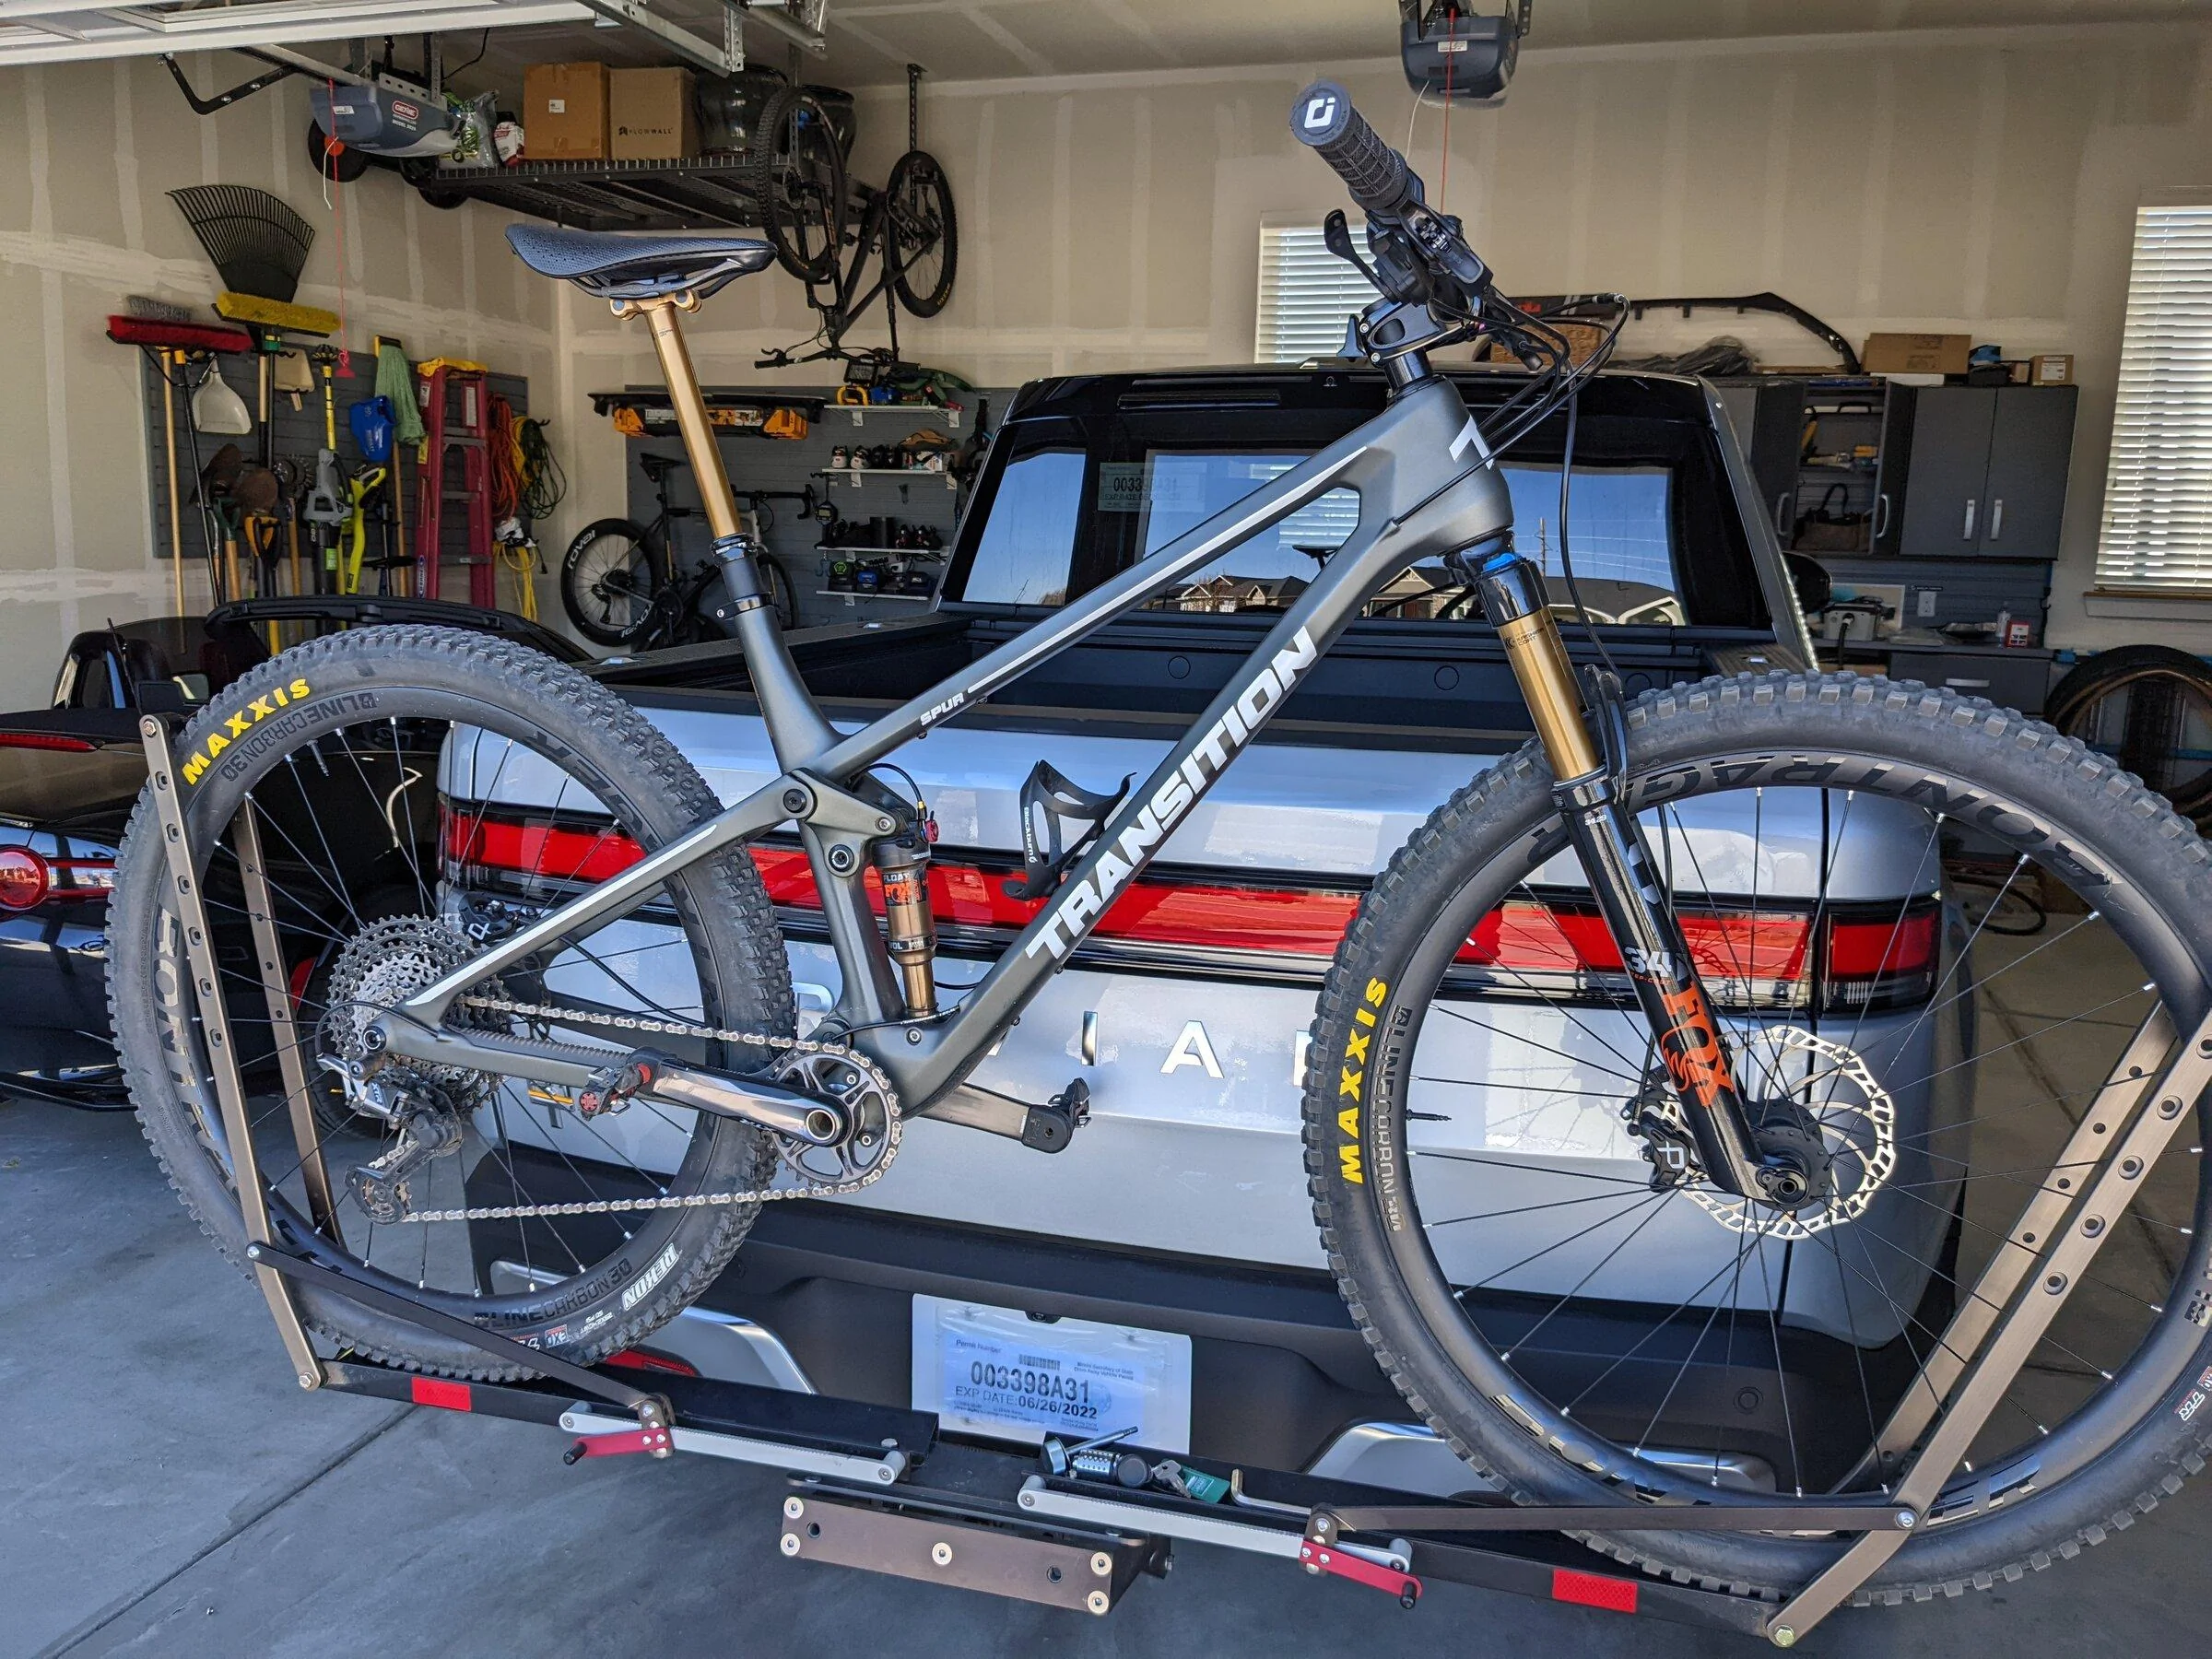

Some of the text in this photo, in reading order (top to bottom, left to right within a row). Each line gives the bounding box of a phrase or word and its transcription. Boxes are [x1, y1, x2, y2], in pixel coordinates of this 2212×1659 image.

[567, 529, 596, 570] roval
[182, 678, 311, 786] MAXXIS
[920, 692, 965, 726] SPUR
[1025, 625, 1318, 960] TRANSITION
[1024, 806, 1034, 859] Blackburn
[884, 882, 912, 903] FOX
[1625, 947, 1673, 978] 34
[1661, 981, 1736, 1109] FOX
[1338, 977, 1387, 1185] MAXXIS
[622, 1242, 680, 1312] REKON
[955, 1385, 980, 1398] EXP
[971, 1360, 1089, 1404] 003398A31
